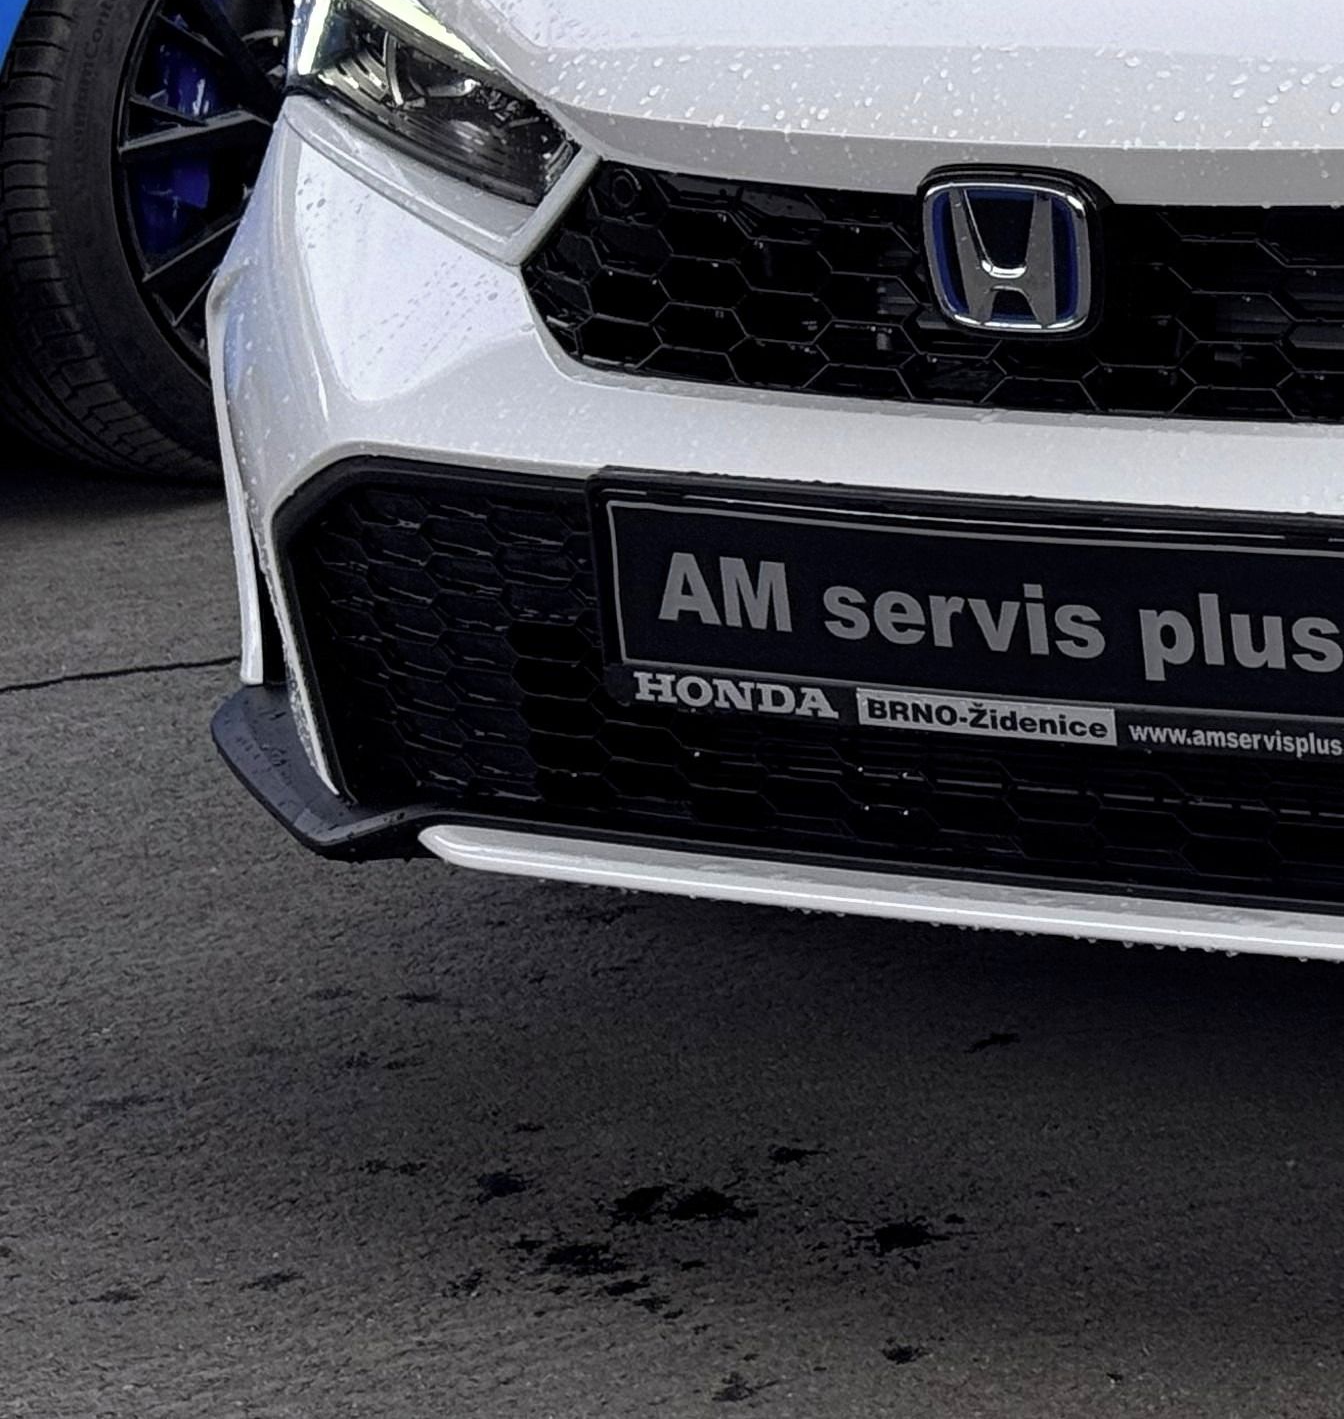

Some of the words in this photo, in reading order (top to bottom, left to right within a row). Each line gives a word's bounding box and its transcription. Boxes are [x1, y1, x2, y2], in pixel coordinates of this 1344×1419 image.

[948, 186, 1056, 328] H
[659, 553, 792, 632] AM
[824, 584, 1105, 658] servis
[1139, 593, 1343, 681] plus
[633, 671, 839, 719] HONDA
[866, 698, 1109, 738] BRNO-Židenice
